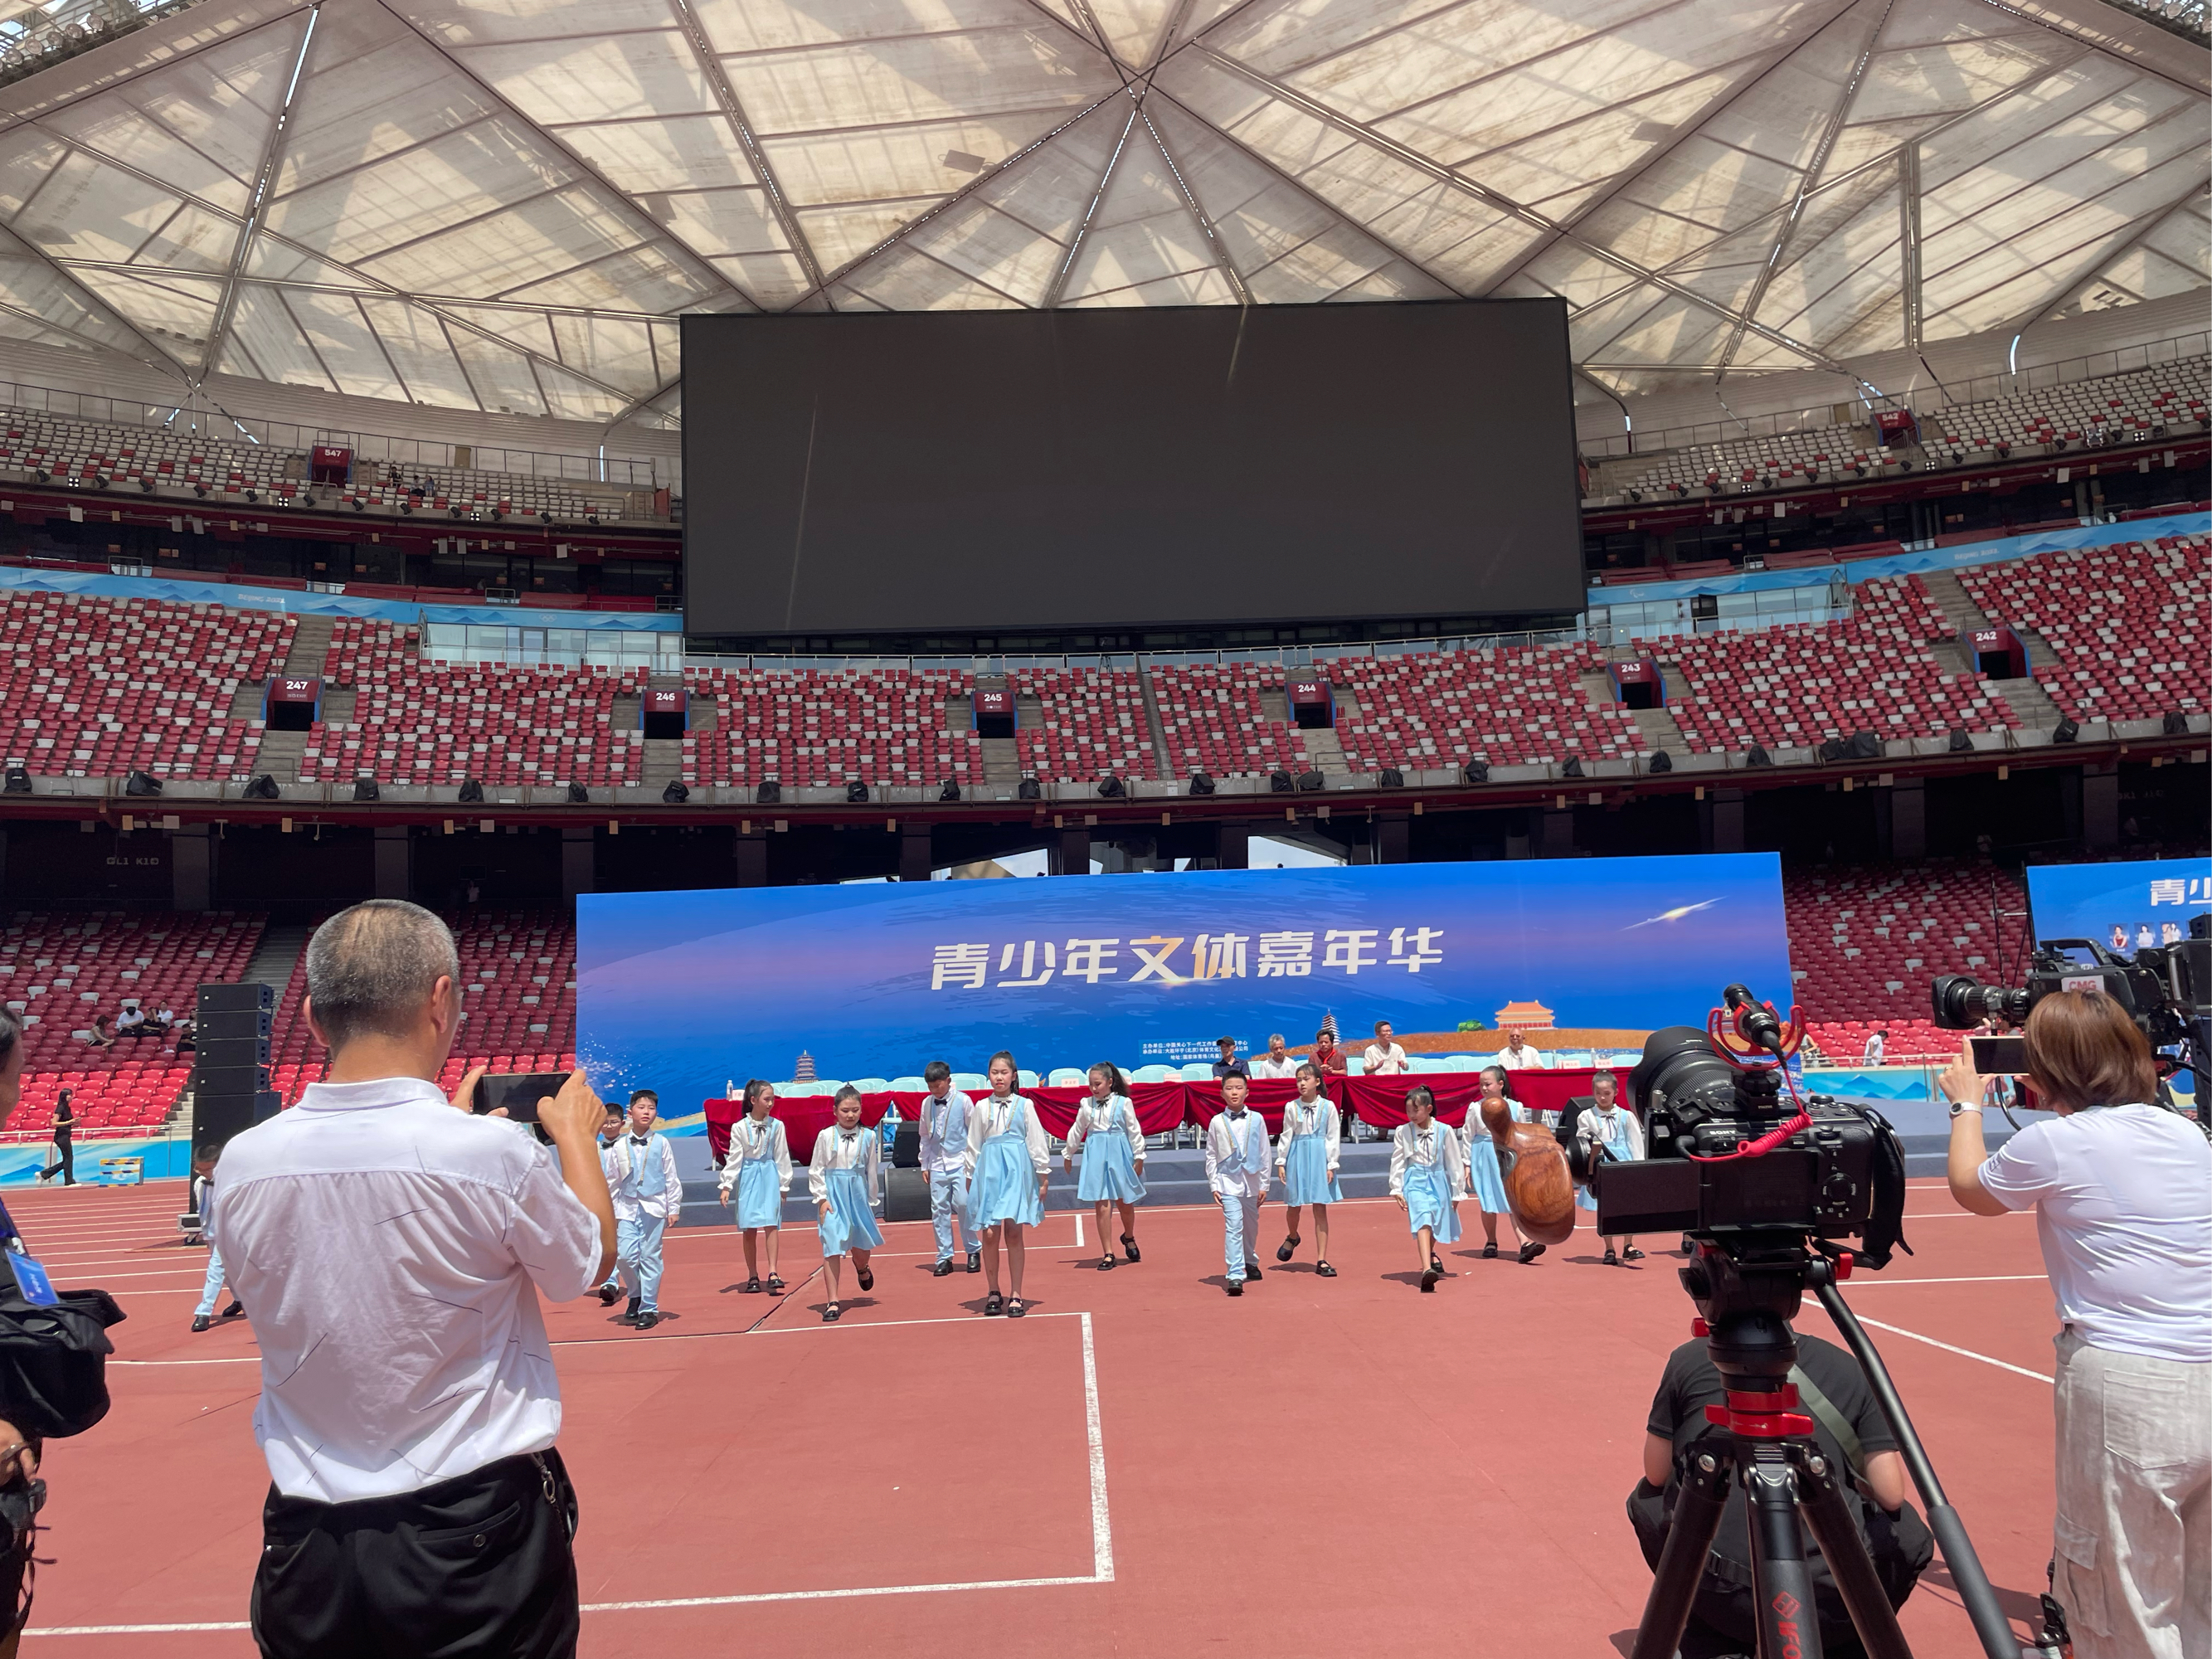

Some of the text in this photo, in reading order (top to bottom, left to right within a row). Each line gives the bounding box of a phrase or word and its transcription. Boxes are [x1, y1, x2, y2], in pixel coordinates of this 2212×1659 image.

[1882, 412, 1898, 421] 542
[324, 449, 342, 457] 547
[1976, 630, 1997, 641] 242
[1621, 664, 1641, 673] 243
[286, 680, 309, 690] 247
[1298, 684, 1316, 693] 244
[656, 692, 675, 701] 246
[984, 693, 1003, 702] 245
[931, 927, 1444, 990] 青少年文体嘉年华
[2069, 980, 2097, 990] CMG
